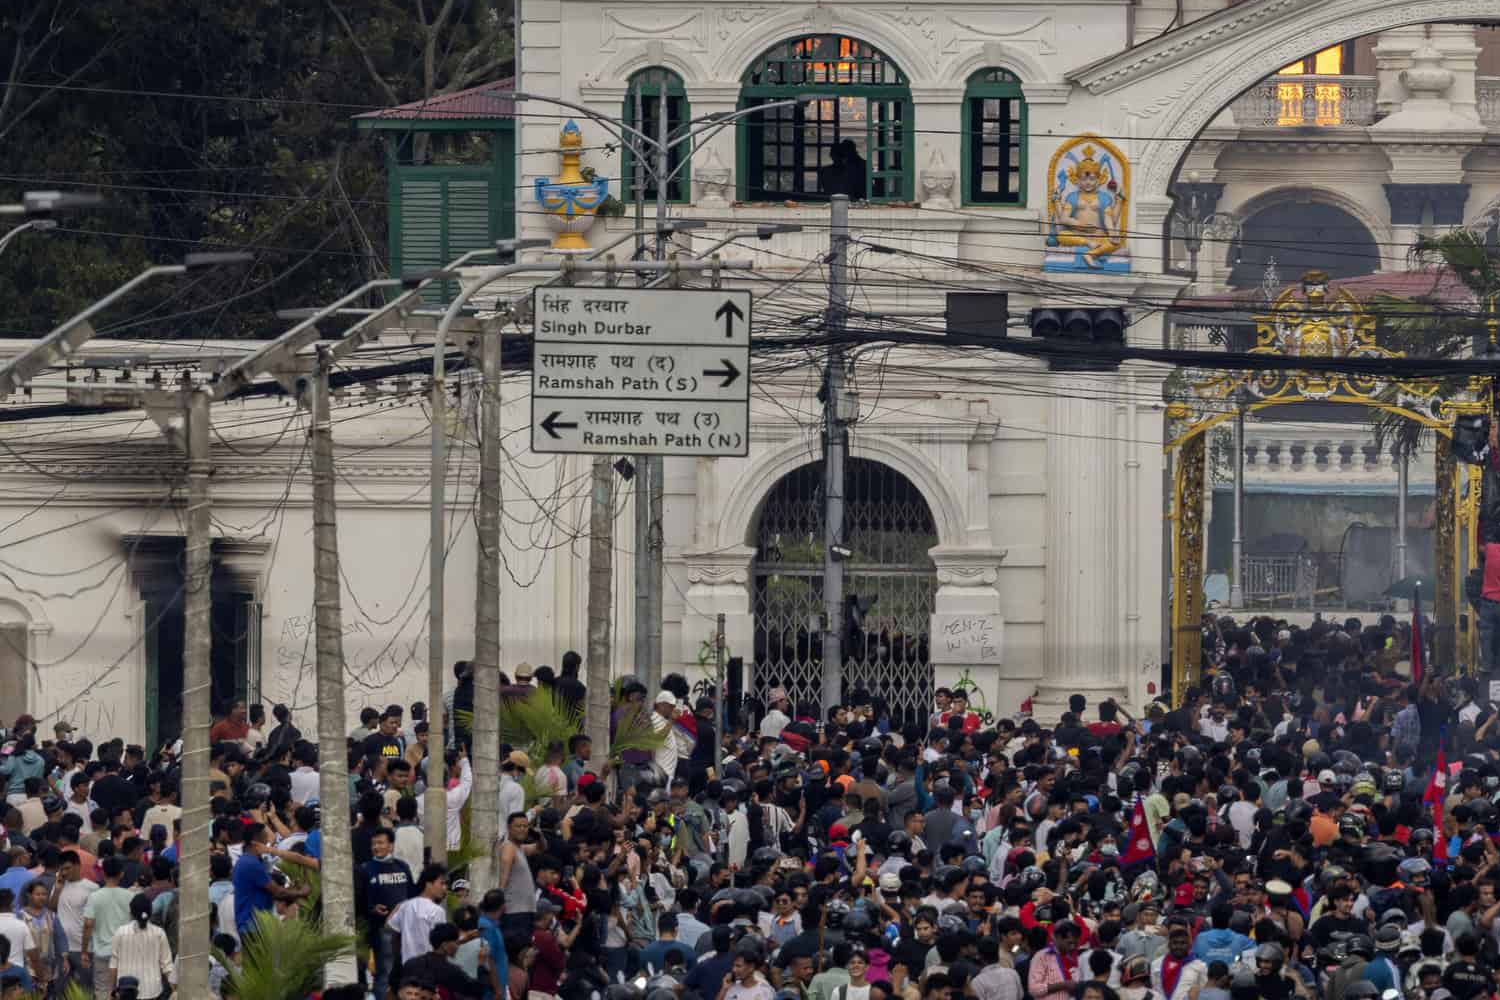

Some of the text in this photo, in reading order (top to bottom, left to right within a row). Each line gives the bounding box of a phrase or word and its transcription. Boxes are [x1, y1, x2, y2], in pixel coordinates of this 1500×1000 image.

[542, 294, 572, 313] सिंह
[541, 320, 652, 336] Singh Durbar
[540, 353, 675, 374] रामशाह पथ (द)
[539, 376, 614, 390] Ramshah
[622, 376, 659, 391] Path
[584, 410, 721, 430] रामशाह पथ (उ)
[583, 432, 657, 447] Ramshah
[664, 433, 702, 448] Path
